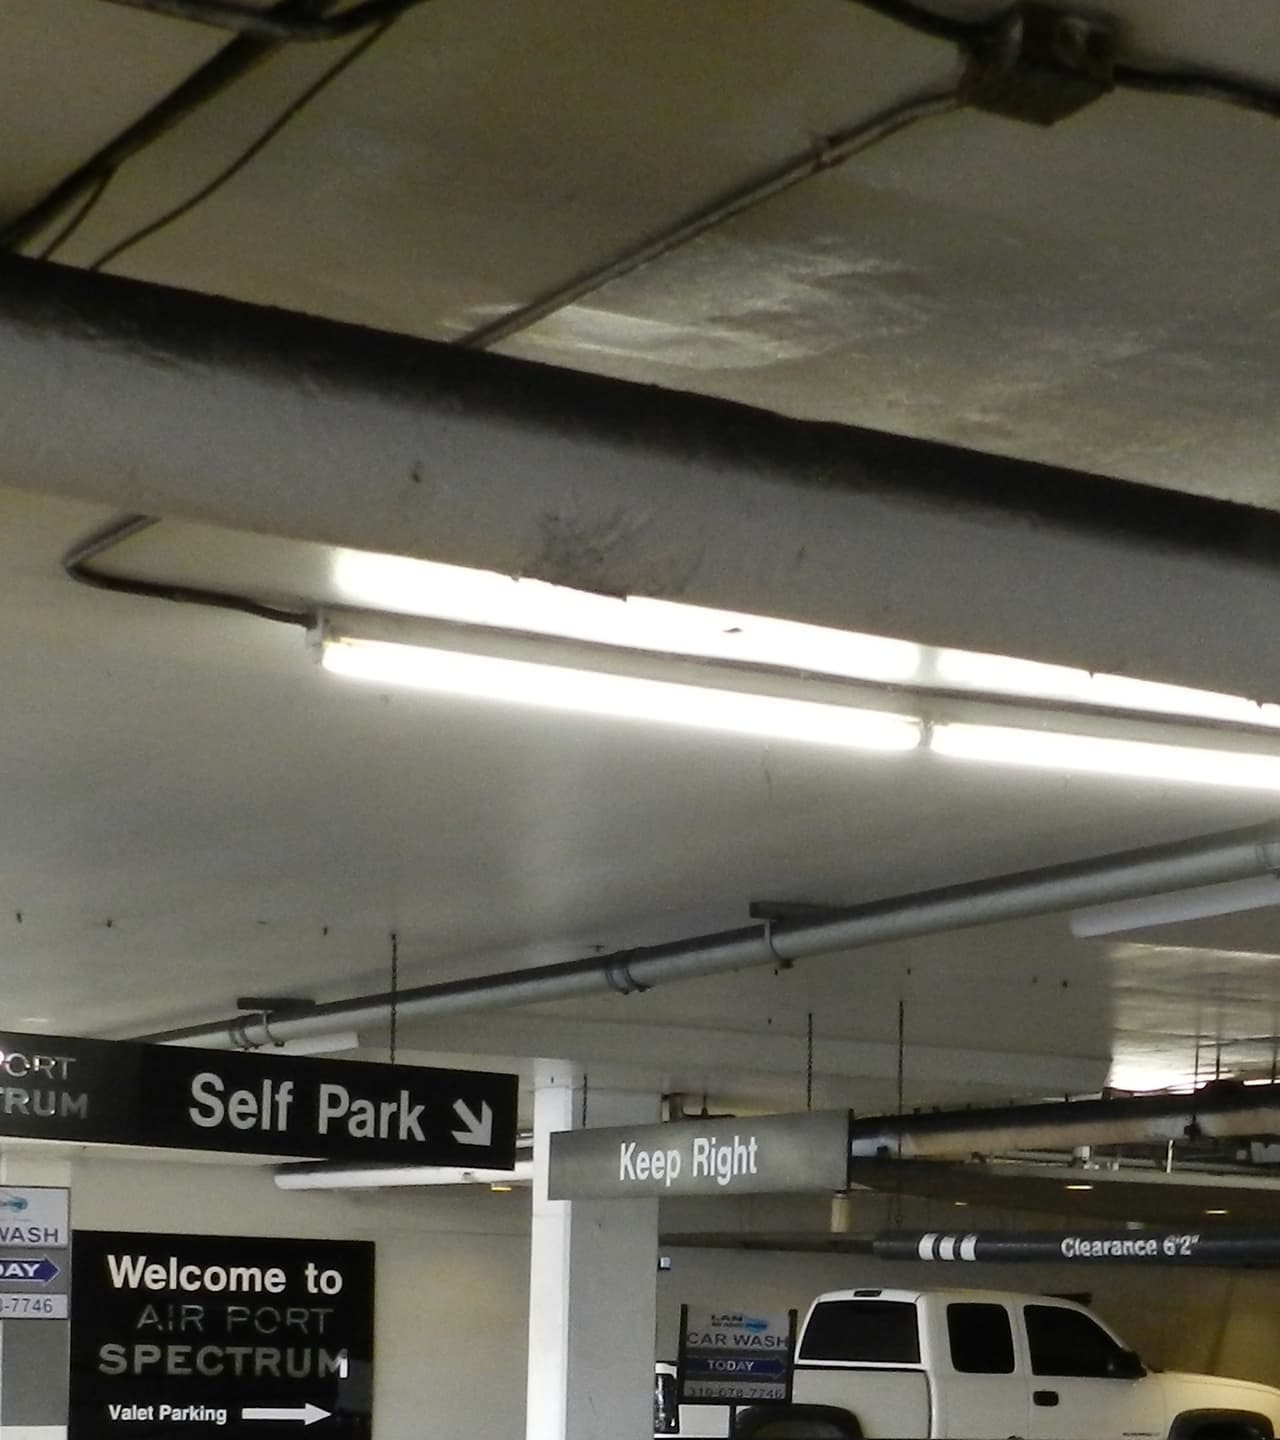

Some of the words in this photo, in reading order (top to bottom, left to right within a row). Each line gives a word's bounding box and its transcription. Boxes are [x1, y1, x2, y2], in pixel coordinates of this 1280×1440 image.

[189, 1071, 295, 1132] Self
[318, 1082, 427, 1142] Park
[619, 1141, 682, 1188] Keep
[692, 1135, 759, 1187] Right
[1060, 1236, 1158, 1258] Clearance
[106, 1254, 287, 1294] Welcome
[304, 1262, 344, 1295] to
[136, 1303, 205, 1333] AIR
[226, 1305, 335, 1335] PORT
[687, 1332, 728, 1346] CAR
[733, 1334, 790, 1348] WASH
[98, 1343, 350, 1379] SPECTRUM
[707, 1360, 755, 1372] TODAY
[108, 1404, 154, 1422] Valet
[158, 1405, 228, 1425] Parking
